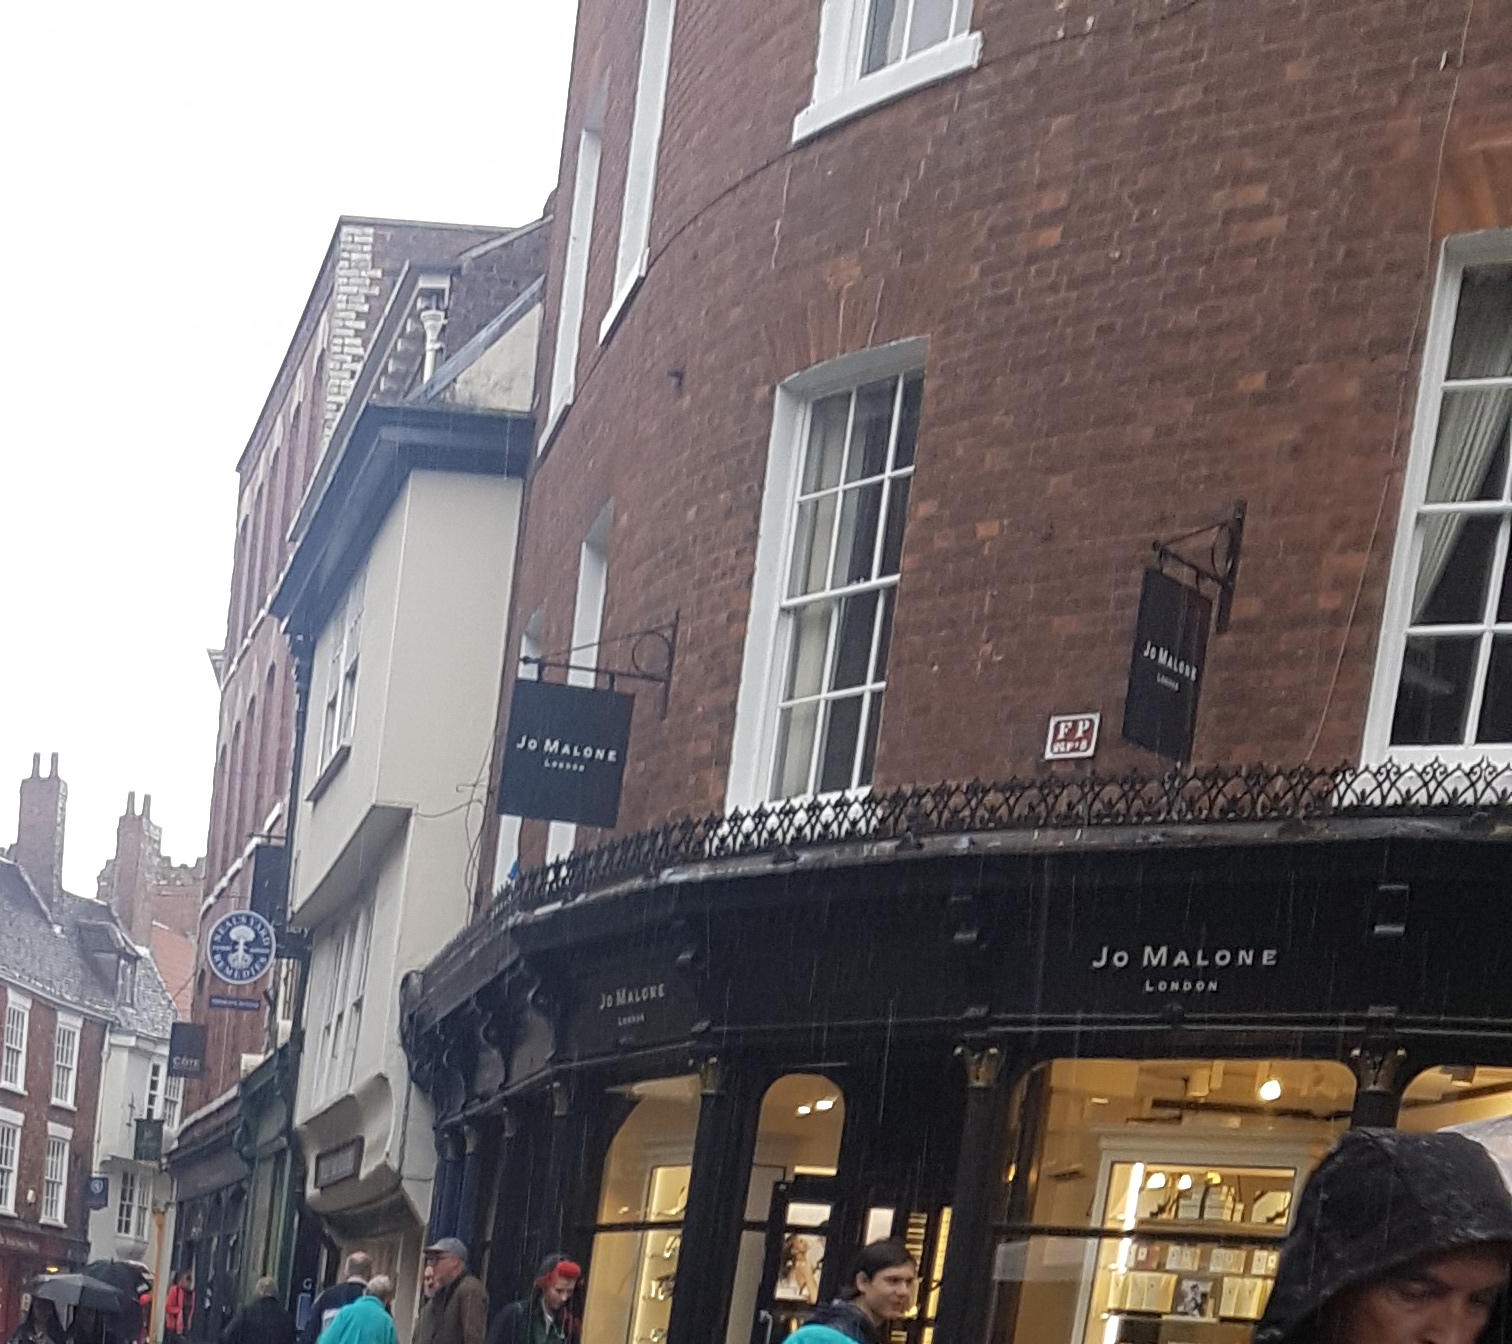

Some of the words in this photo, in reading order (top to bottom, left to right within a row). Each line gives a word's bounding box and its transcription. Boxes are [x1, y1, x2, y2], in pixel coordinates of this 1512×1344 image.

[543, 738, 617, 762] MALONE
[1092, 945, 1129, 968] JO
[1142, 945, 1278, 967] MALONE
[615, 983, 665, 1006] MALONE
[1145, 979, 1218, 992] LONDON
